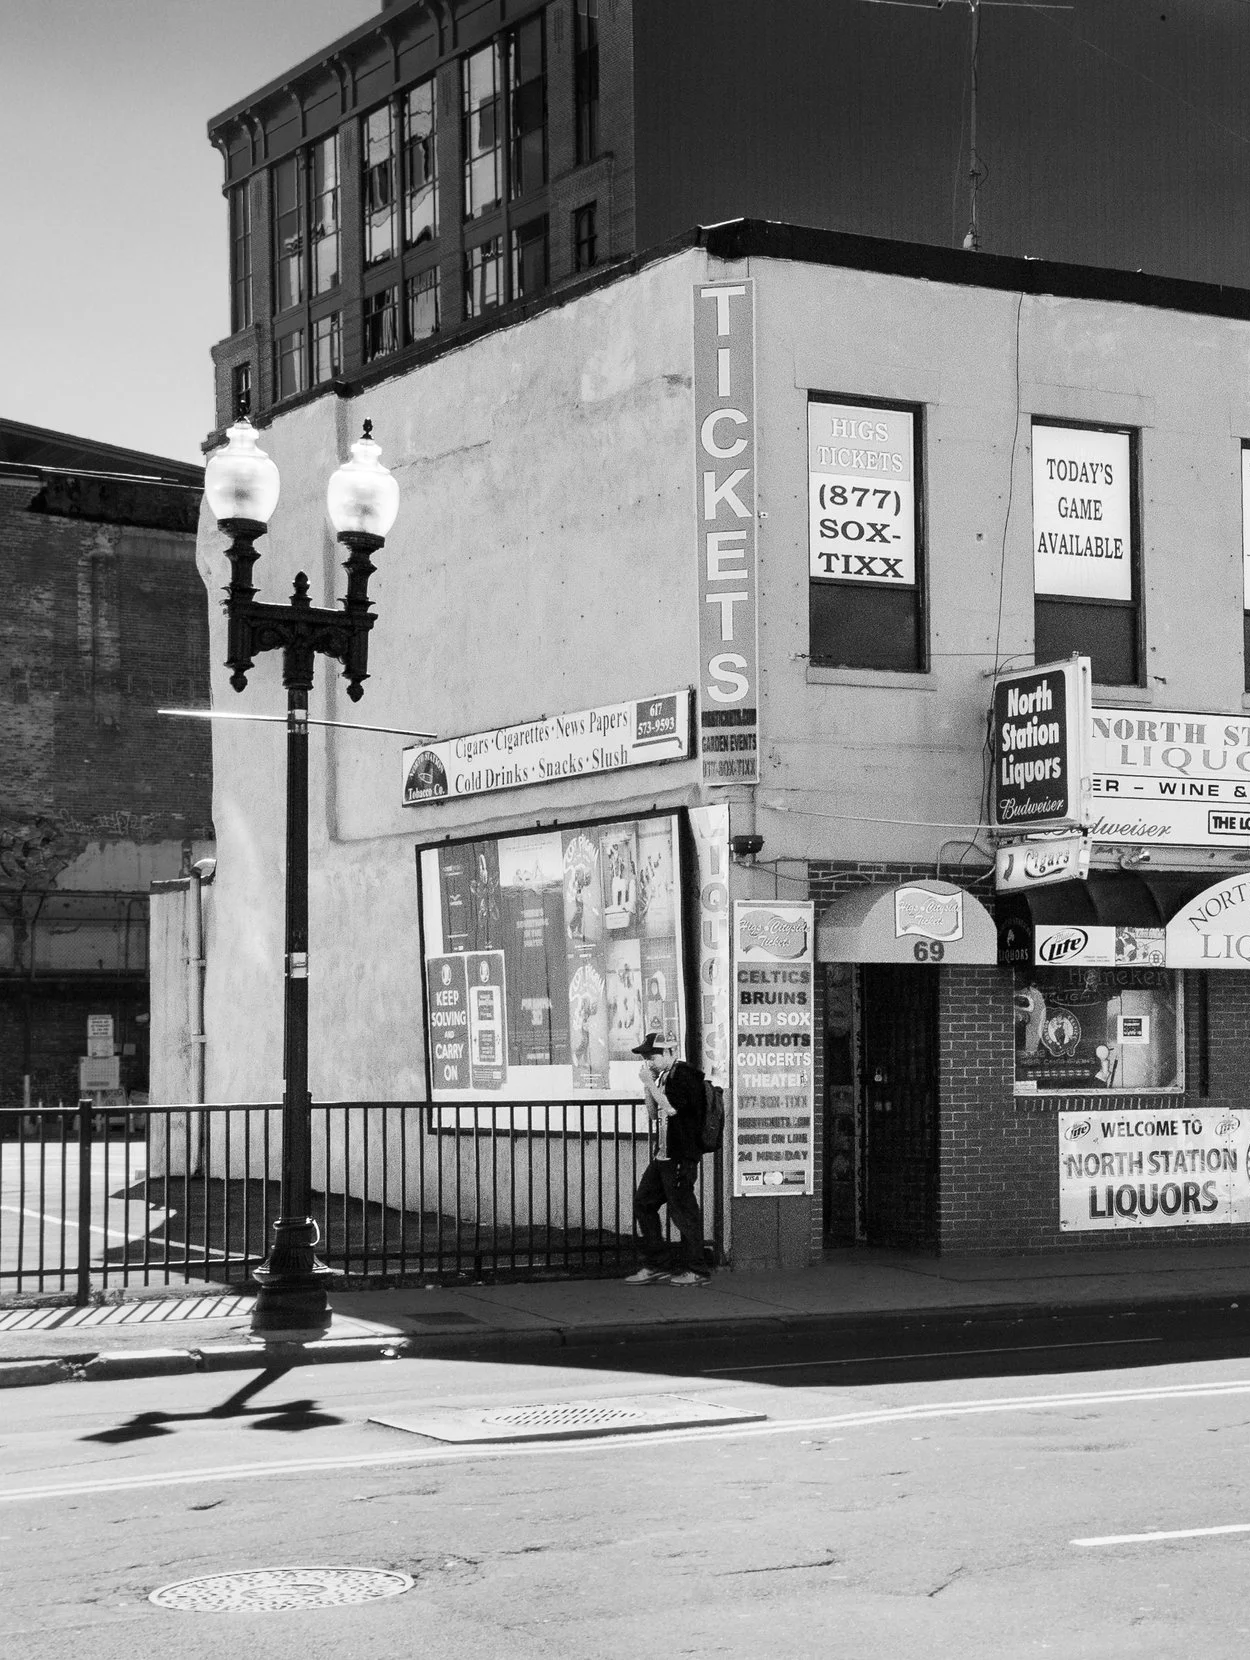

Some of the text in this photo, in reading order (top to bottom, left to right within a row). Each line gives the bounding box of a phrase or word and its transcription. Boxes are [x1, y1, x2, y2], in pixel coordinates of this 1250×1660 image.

[831, 417, 889, 442] HIGS
[817, 445, 903, 472] TICKETS
[1046, 458, 1114, 485] TODAY'S
[700, 285, 752, 703] TICKETS
[819, 484, 902, 516] (877)
[1057, 496, 1104, 522] GAME
[819, 519, 902, 543] SOX-
[1037, 531, 1124, 560] AVAILABLE
[818, 552, 904, 579] TIXX
[649, 702, 663, 717] 617
[1007, 679, 1052, 718] North
[455, 708, 628, 763] Cigars Cigarettes News Papers
[637, 717, 676, 736] 573-9593
[1001, 715, 1060, 752] Station
[1092, 717, 1207, 745] NORTH
[455, 745, 628, 794] Cold Drinks Snacks Slush
[1001, 753, 1062, 790] Liquors
[408, 787, 433, 801] Tobacco
[1159, 782, 1220, 797] WINE
[1234, 785, 1247, 798] &
[1000, 796, 1064, 820] Budweiser
[1212, 815, 1236, 829] THE
[1024, 848, 1070, 876] Cigars
[914, 941, 945, 962] 69
[1048, 937, 1082, 962] Lite
[737, 970, 810, 984] CELTICS
[436, 990, 459, 1006] KEEP
[740, 990, 807, 1005] BRUINS
[431, 1010, 467, 1027] SOLVING
[738, 1012, 811, 1026] RED SOX
[435, 1043, 464, 1060] CARRY
[737, 1033, 811, 1047] PATRIOTS
[737, 1052, 812, 1067] CONCERTS
[443, 1064, 458, 1081] ON
[771, 1133, 786, 1145] ON
[1101, 1119, 1203, 1138] WELCOME TO
[737, 1151, 753, 1162] 24
[1066, 1148, 1238, 1178] NORTH STATION
[744, 1175, 760, 1183] VISA
[1089, 1180, 1220, 1222] LIQUORS
